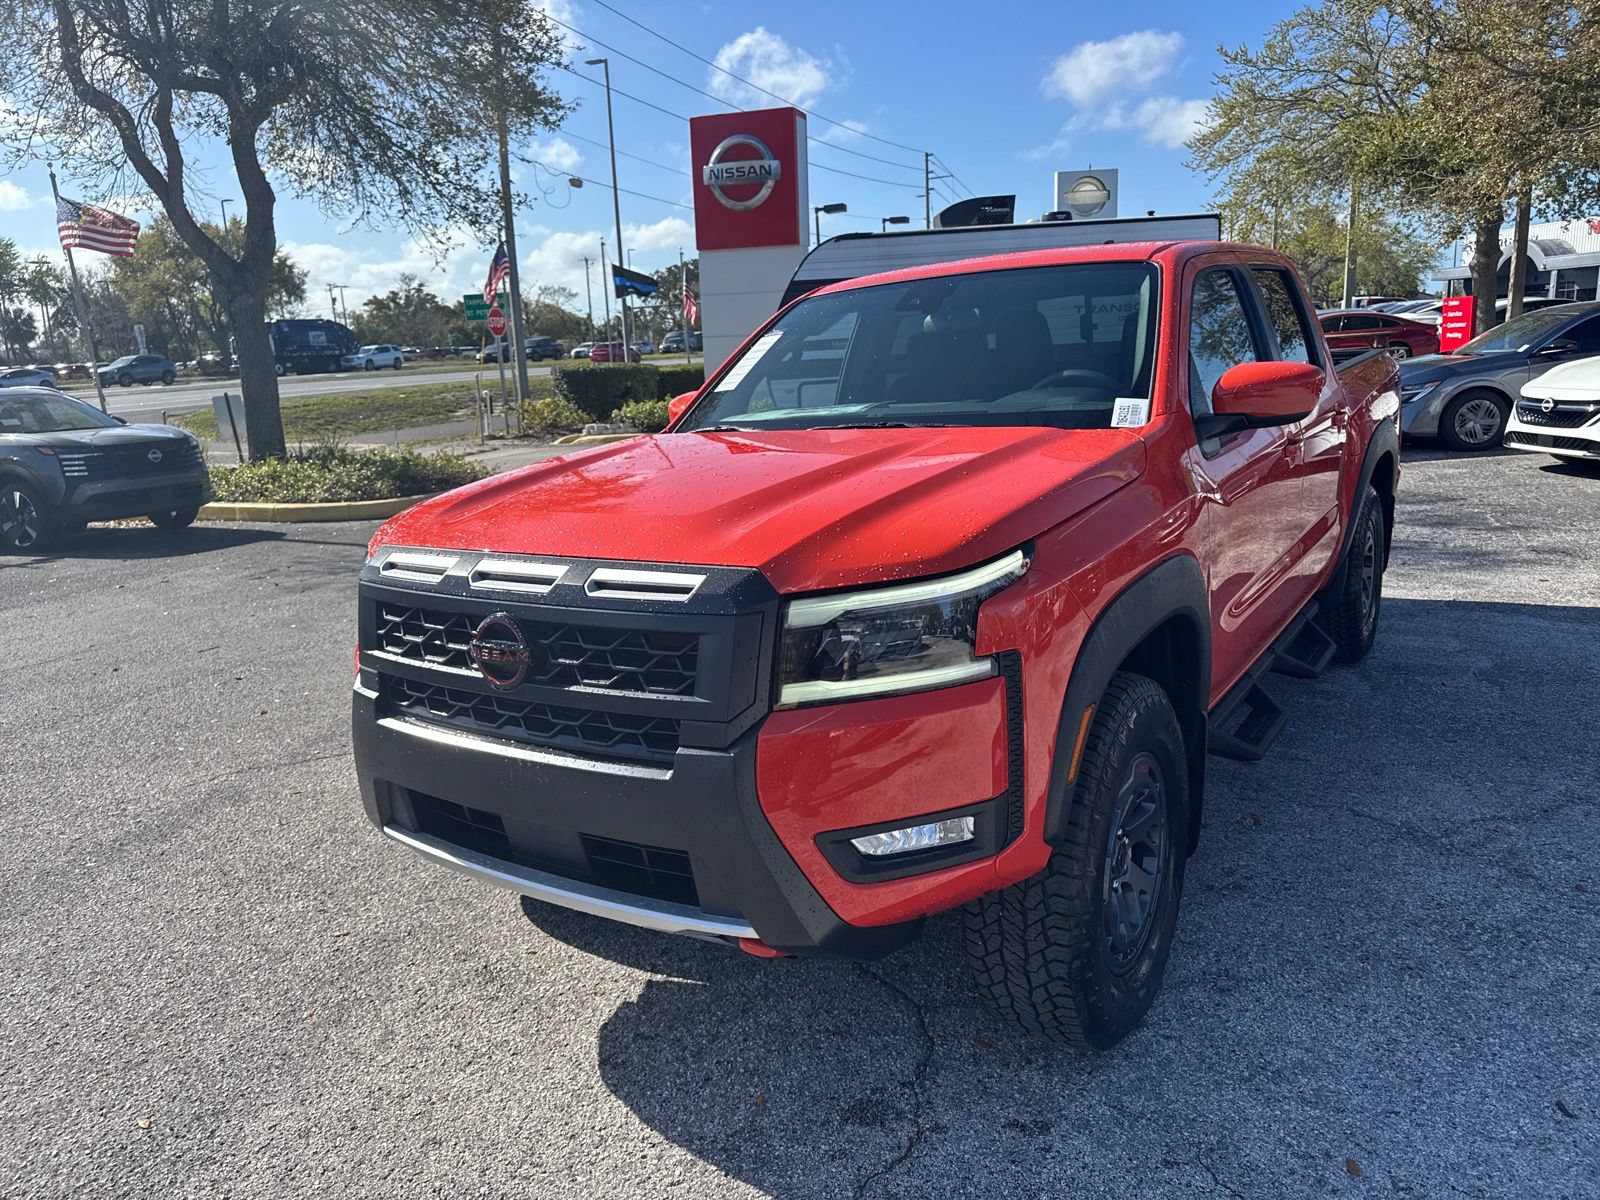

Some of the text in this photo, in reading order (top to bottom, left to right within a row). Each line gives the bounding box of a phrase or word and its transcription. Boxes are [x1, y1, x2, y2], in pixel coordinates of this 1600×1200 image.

[709, 164, 772, 180] NISSAN
[489, 316, 505, 328] STOP
[470, 644, 529, 662] NISSAN
